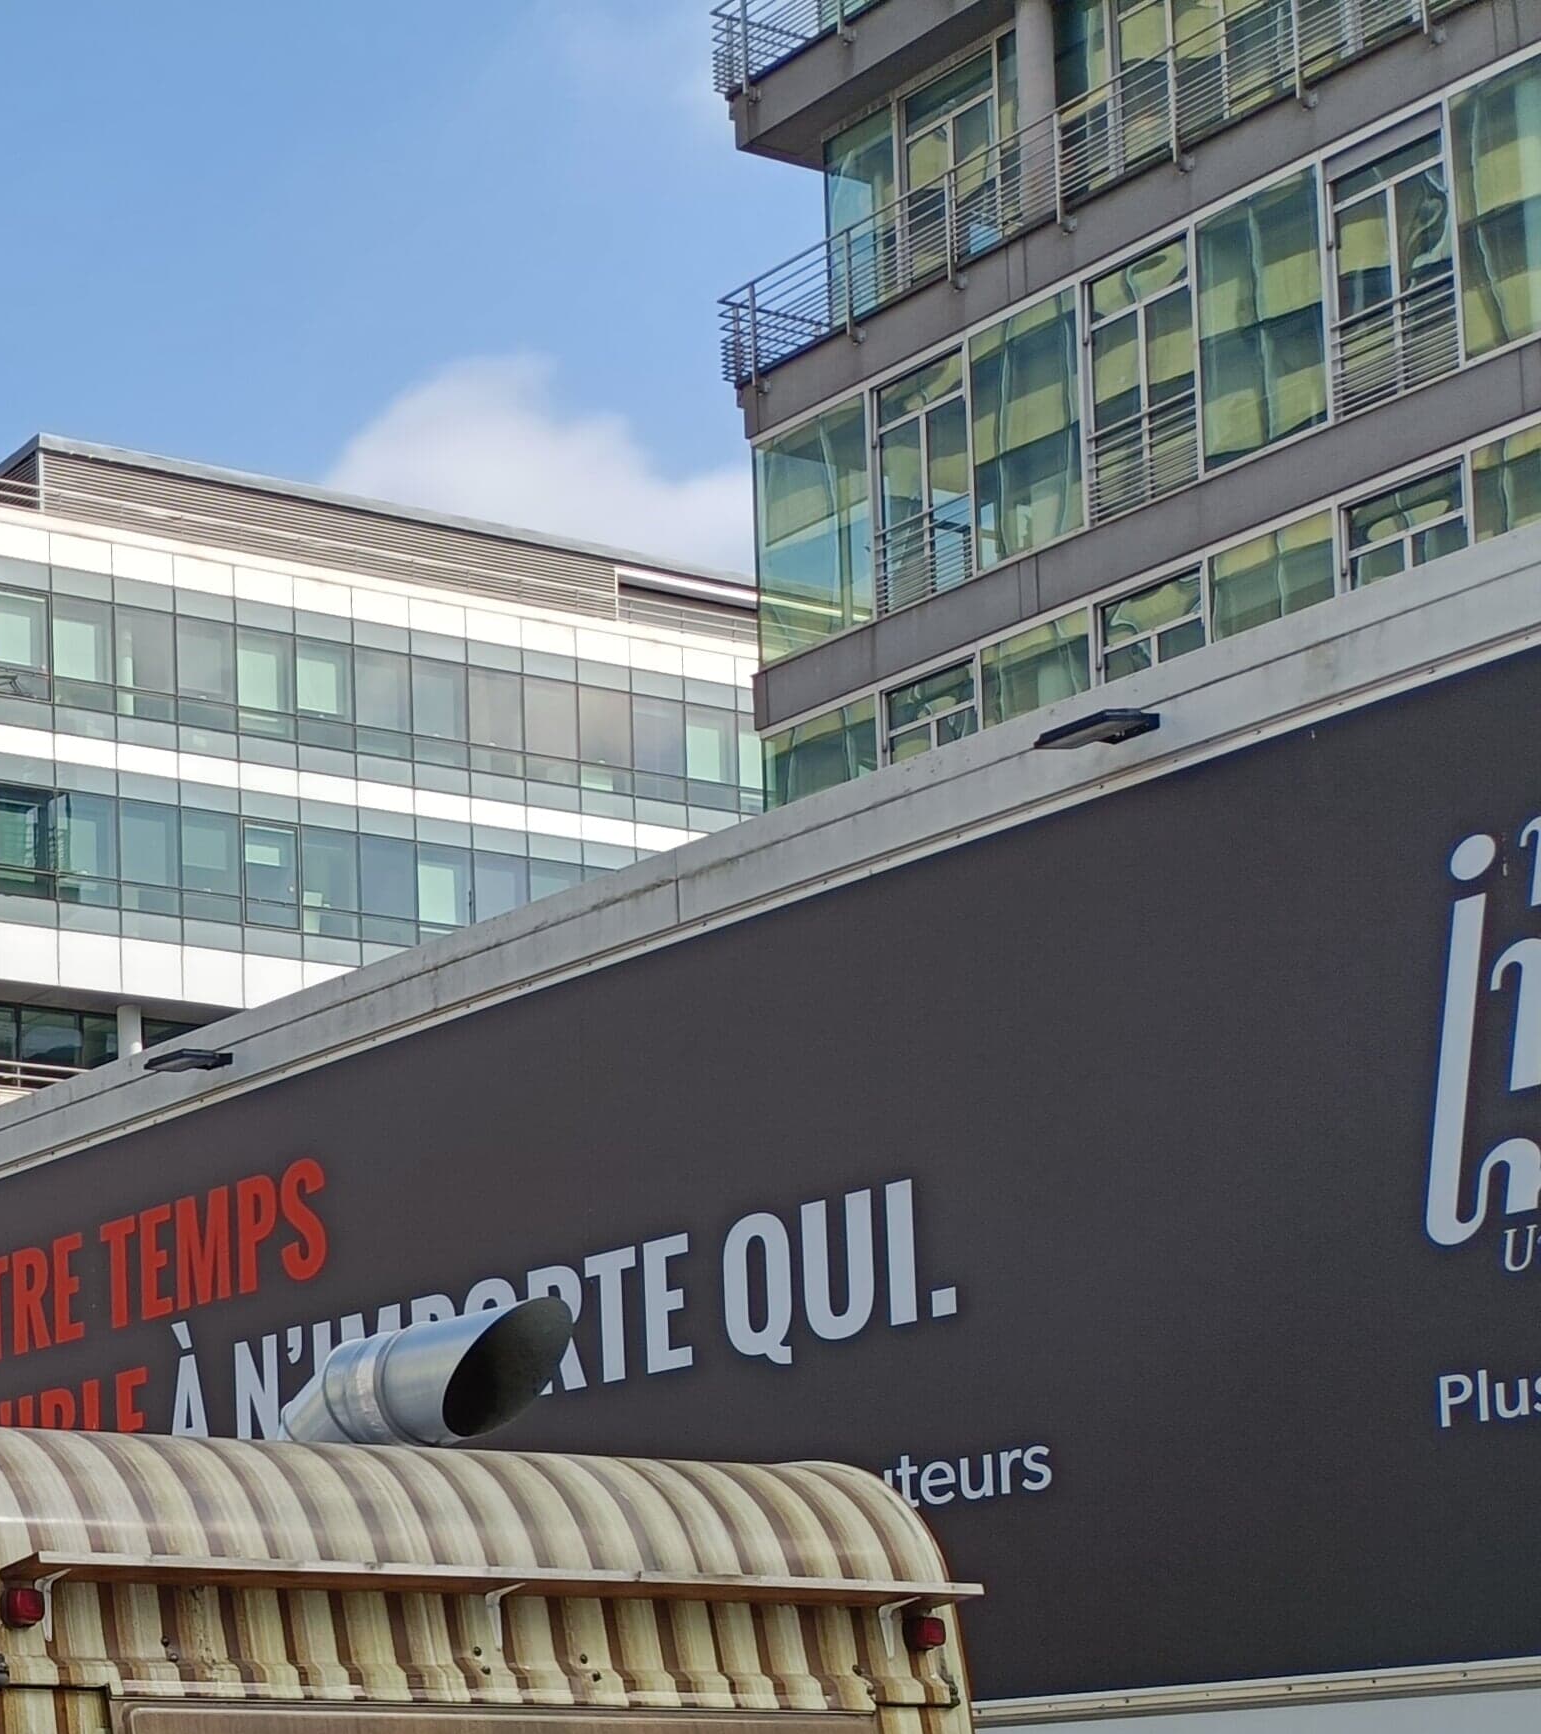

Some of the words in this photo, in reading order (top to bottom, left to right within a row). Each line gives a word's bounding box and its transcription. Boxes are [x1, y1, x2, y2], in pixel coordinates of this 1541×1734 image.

[99, 1157, 327, 1329] TEMPS
[171, 1321, 210, 1439] À
[723, 1179, 958, 1366] QUI.
